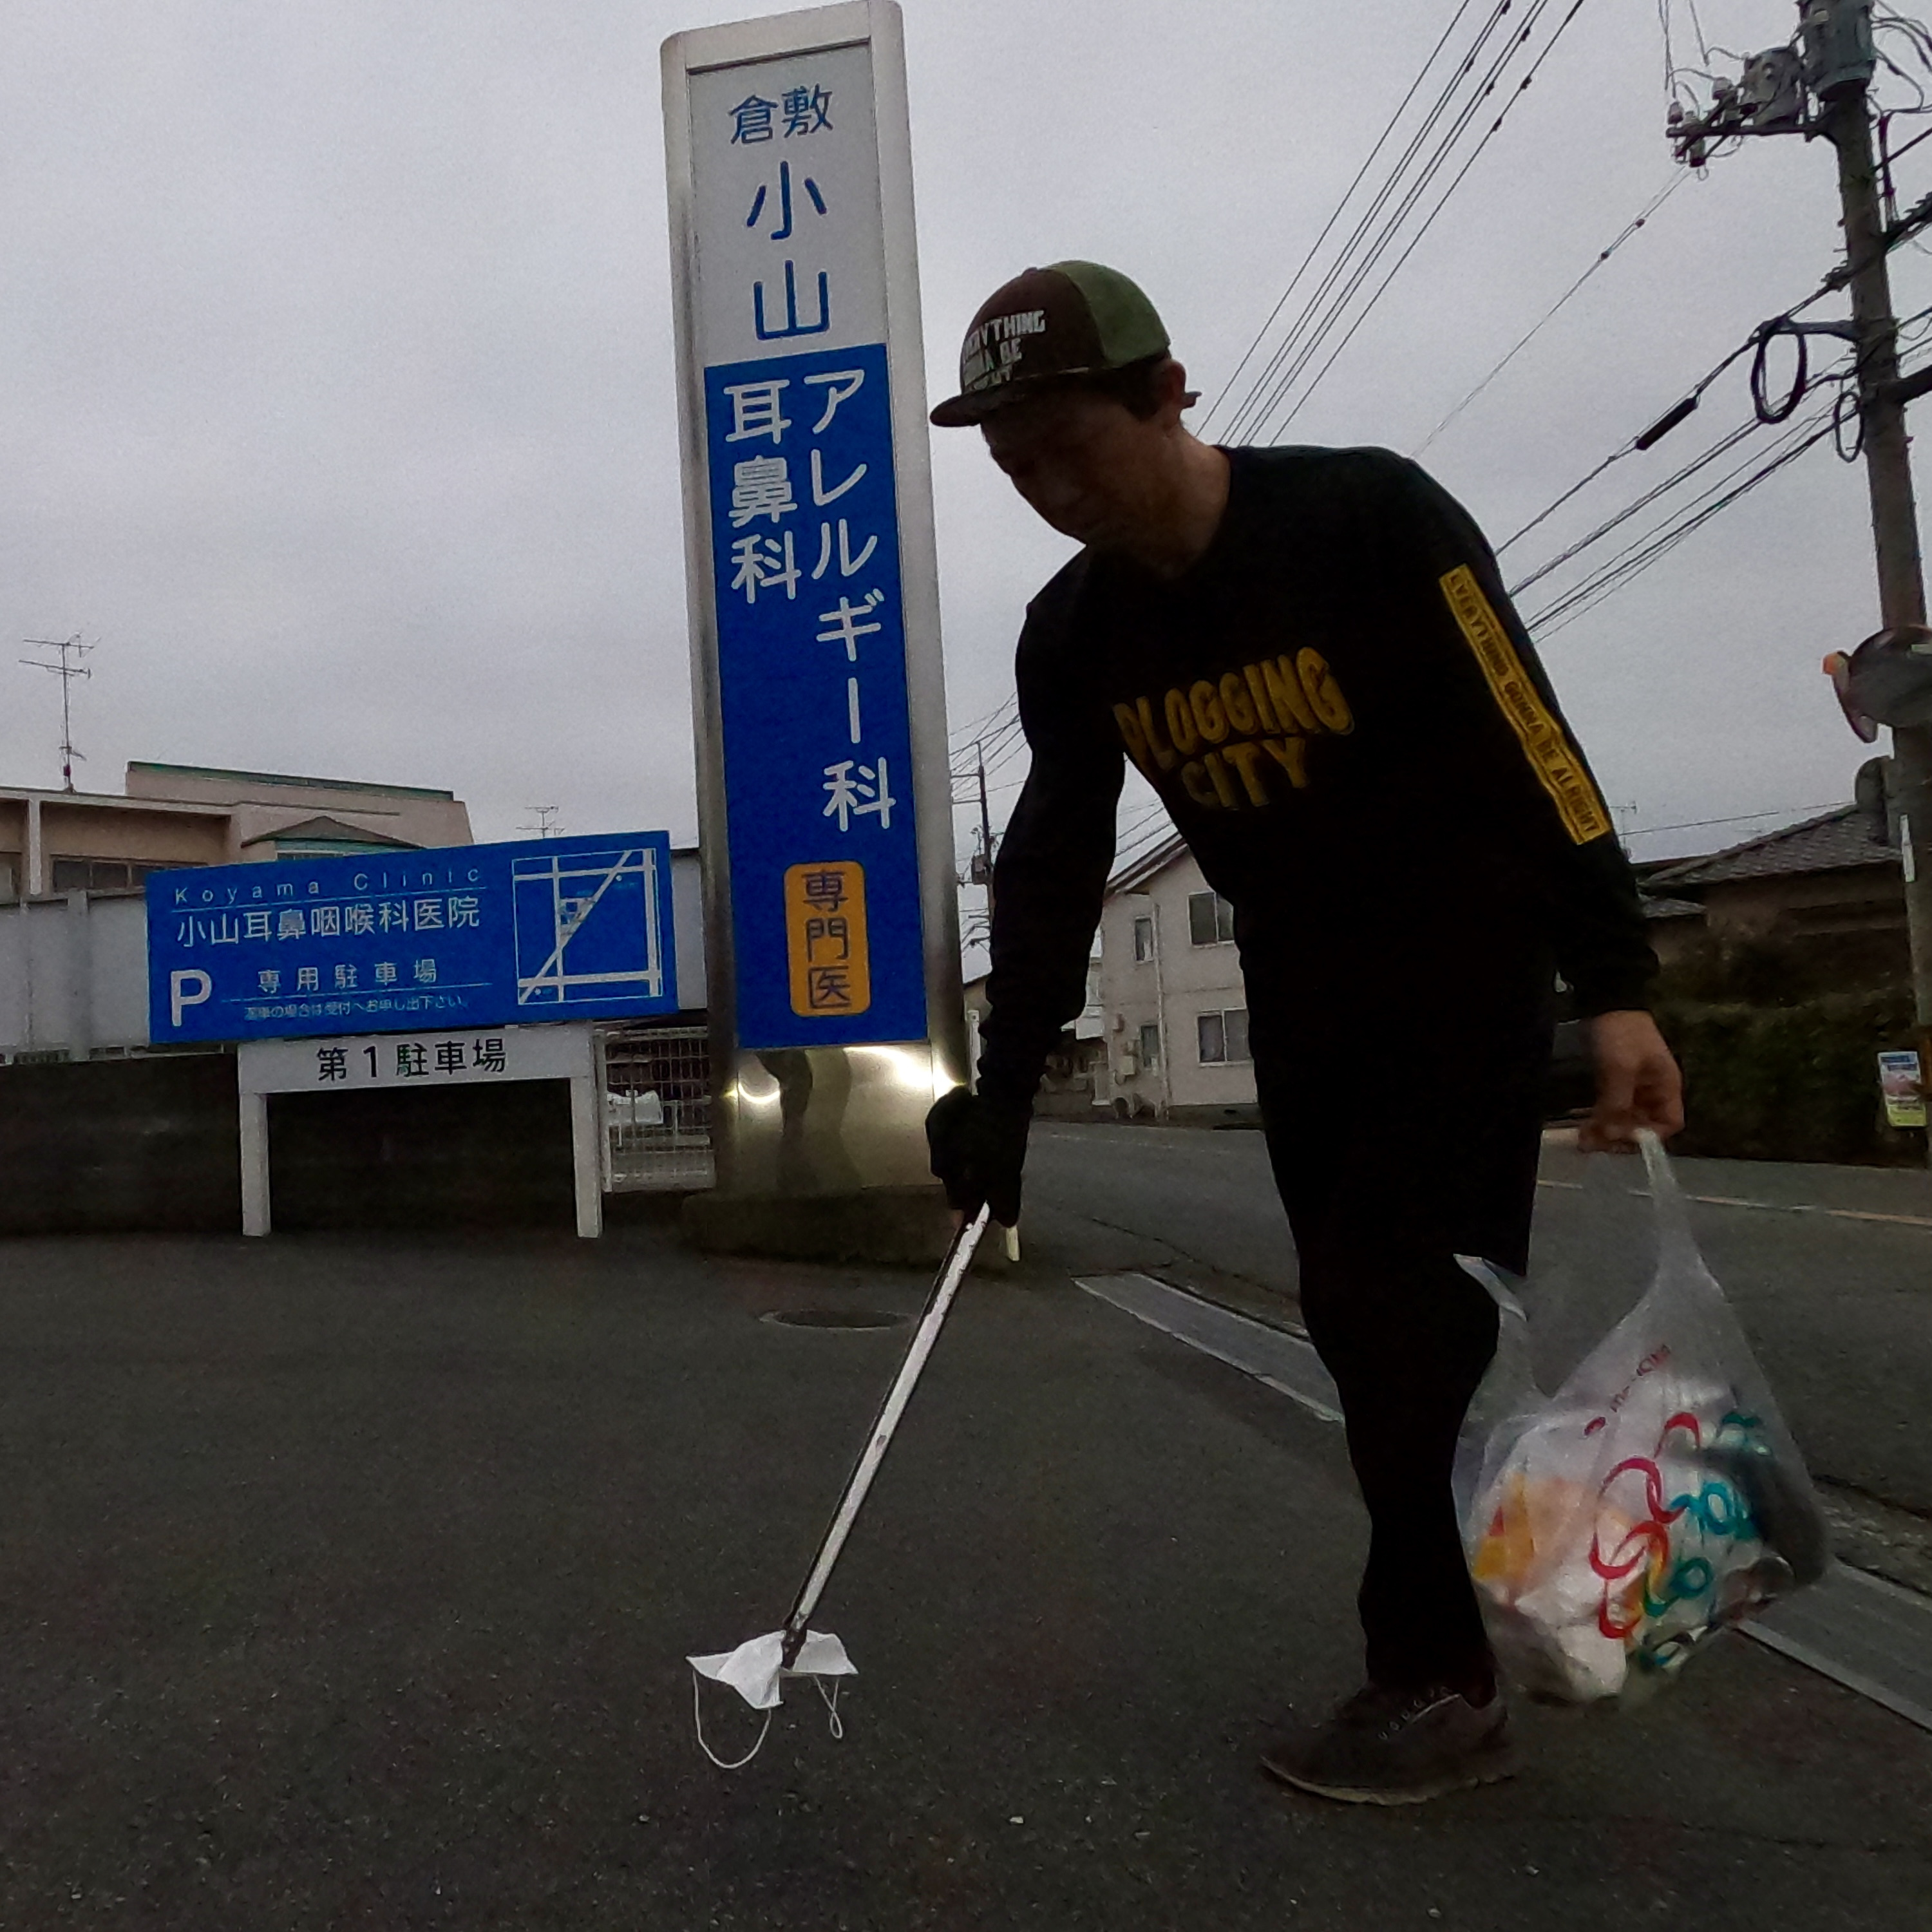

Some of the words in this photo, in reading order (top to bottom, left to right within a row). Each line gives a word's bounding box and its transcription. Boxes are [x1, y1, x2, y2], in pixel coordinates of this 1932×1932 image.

[728, 83, 833, 145] 倉敷
[746, 160, 829, 341] 小山
[723, 379, 802, 604] 耳鼻科
[804, 368, 896, 832] アレルギー科
[1112, 645, 1356, 778] PLOGGING
[1180, 736, 1311, 811] CITY
[1552, 766, 1600, 833] ALRIGHT
[174, 878, 321, 905] Koyama
[353, 867, 480, 892] Clinic
[176, 895, 481, 948] 小山耳鼻咽喉科医院
[801, 868, 852, 1010] 専門医
[169, 969, 213, 1027] P
[257, 958, 438, 994] 専用駐車場
[316, 1038, 506, 1083] 第1駐車場
